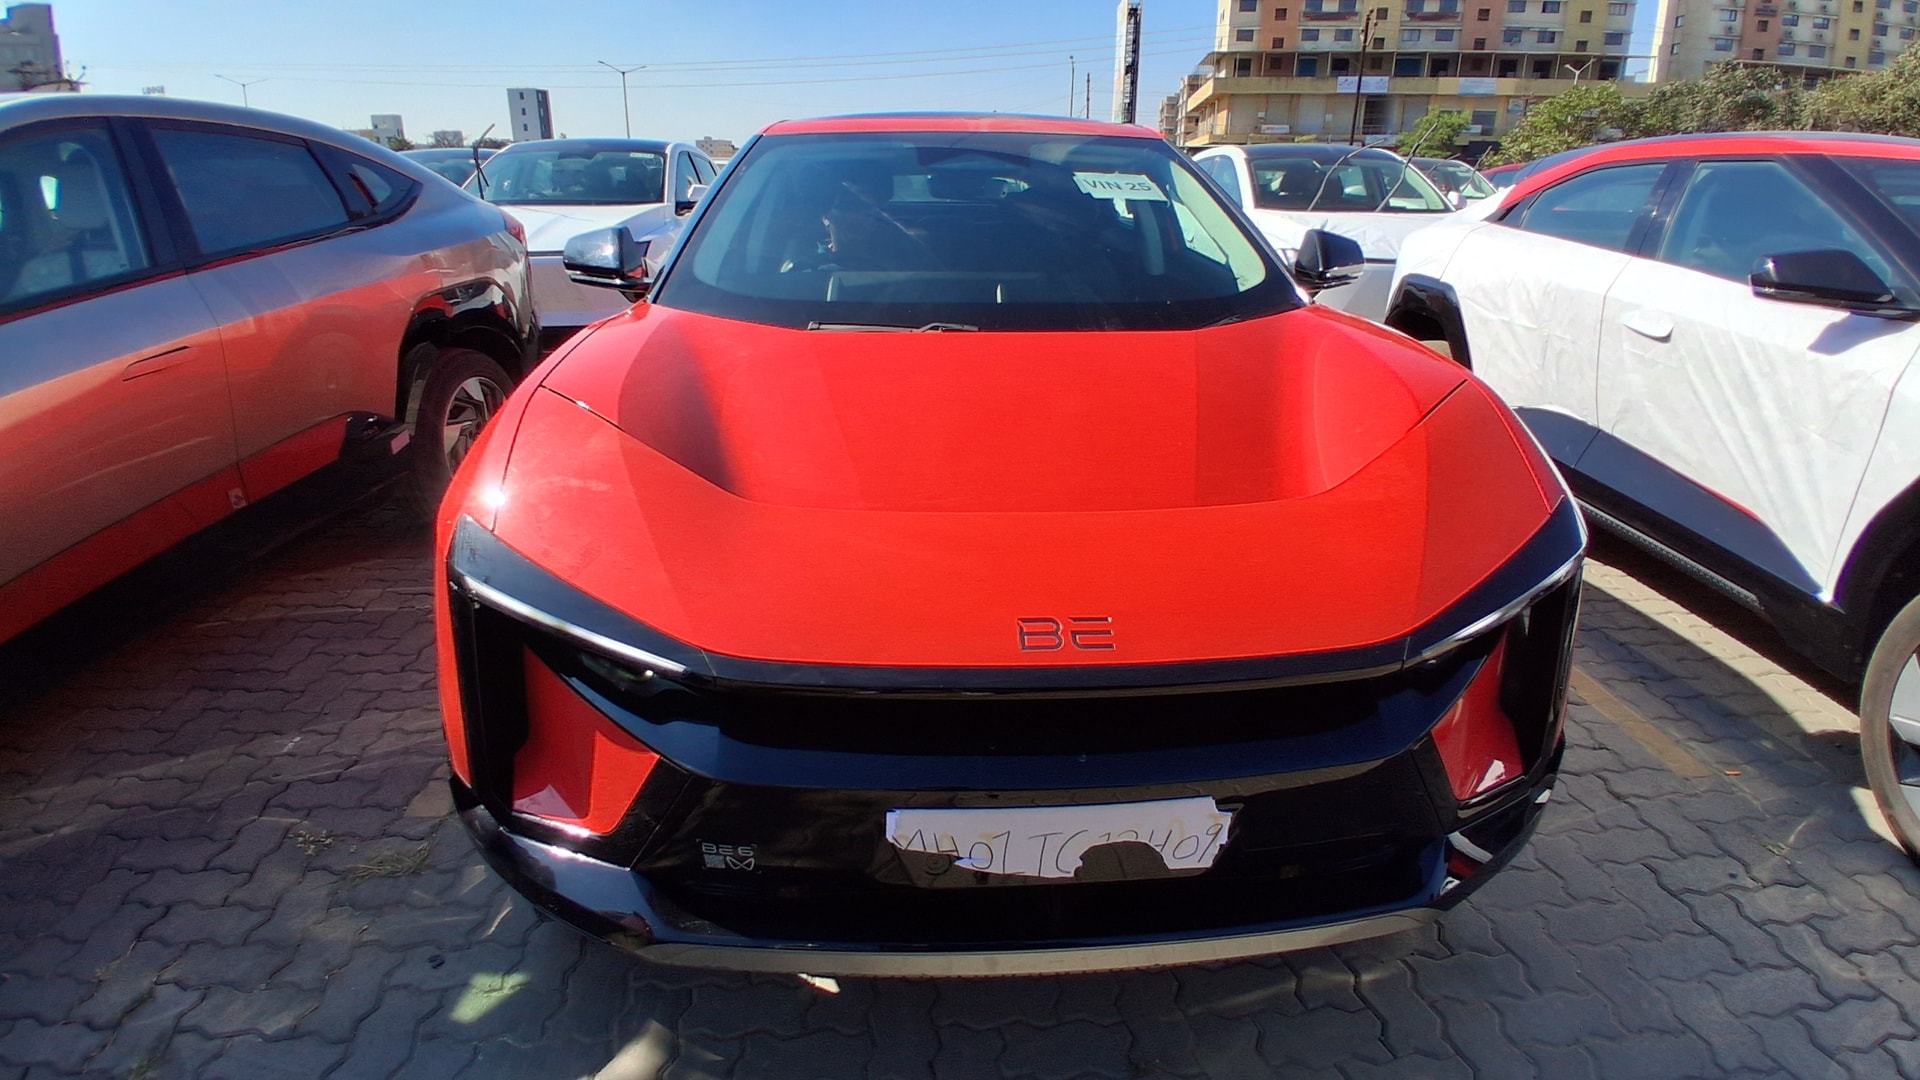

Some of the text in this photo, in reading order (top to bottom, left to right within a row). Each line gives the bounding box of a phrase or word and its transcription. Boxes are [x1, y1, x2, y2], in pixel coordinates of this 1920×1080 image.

[1083, 179, 1152, 192] VIN 25
[1016, 616, 1117, 652] BE
